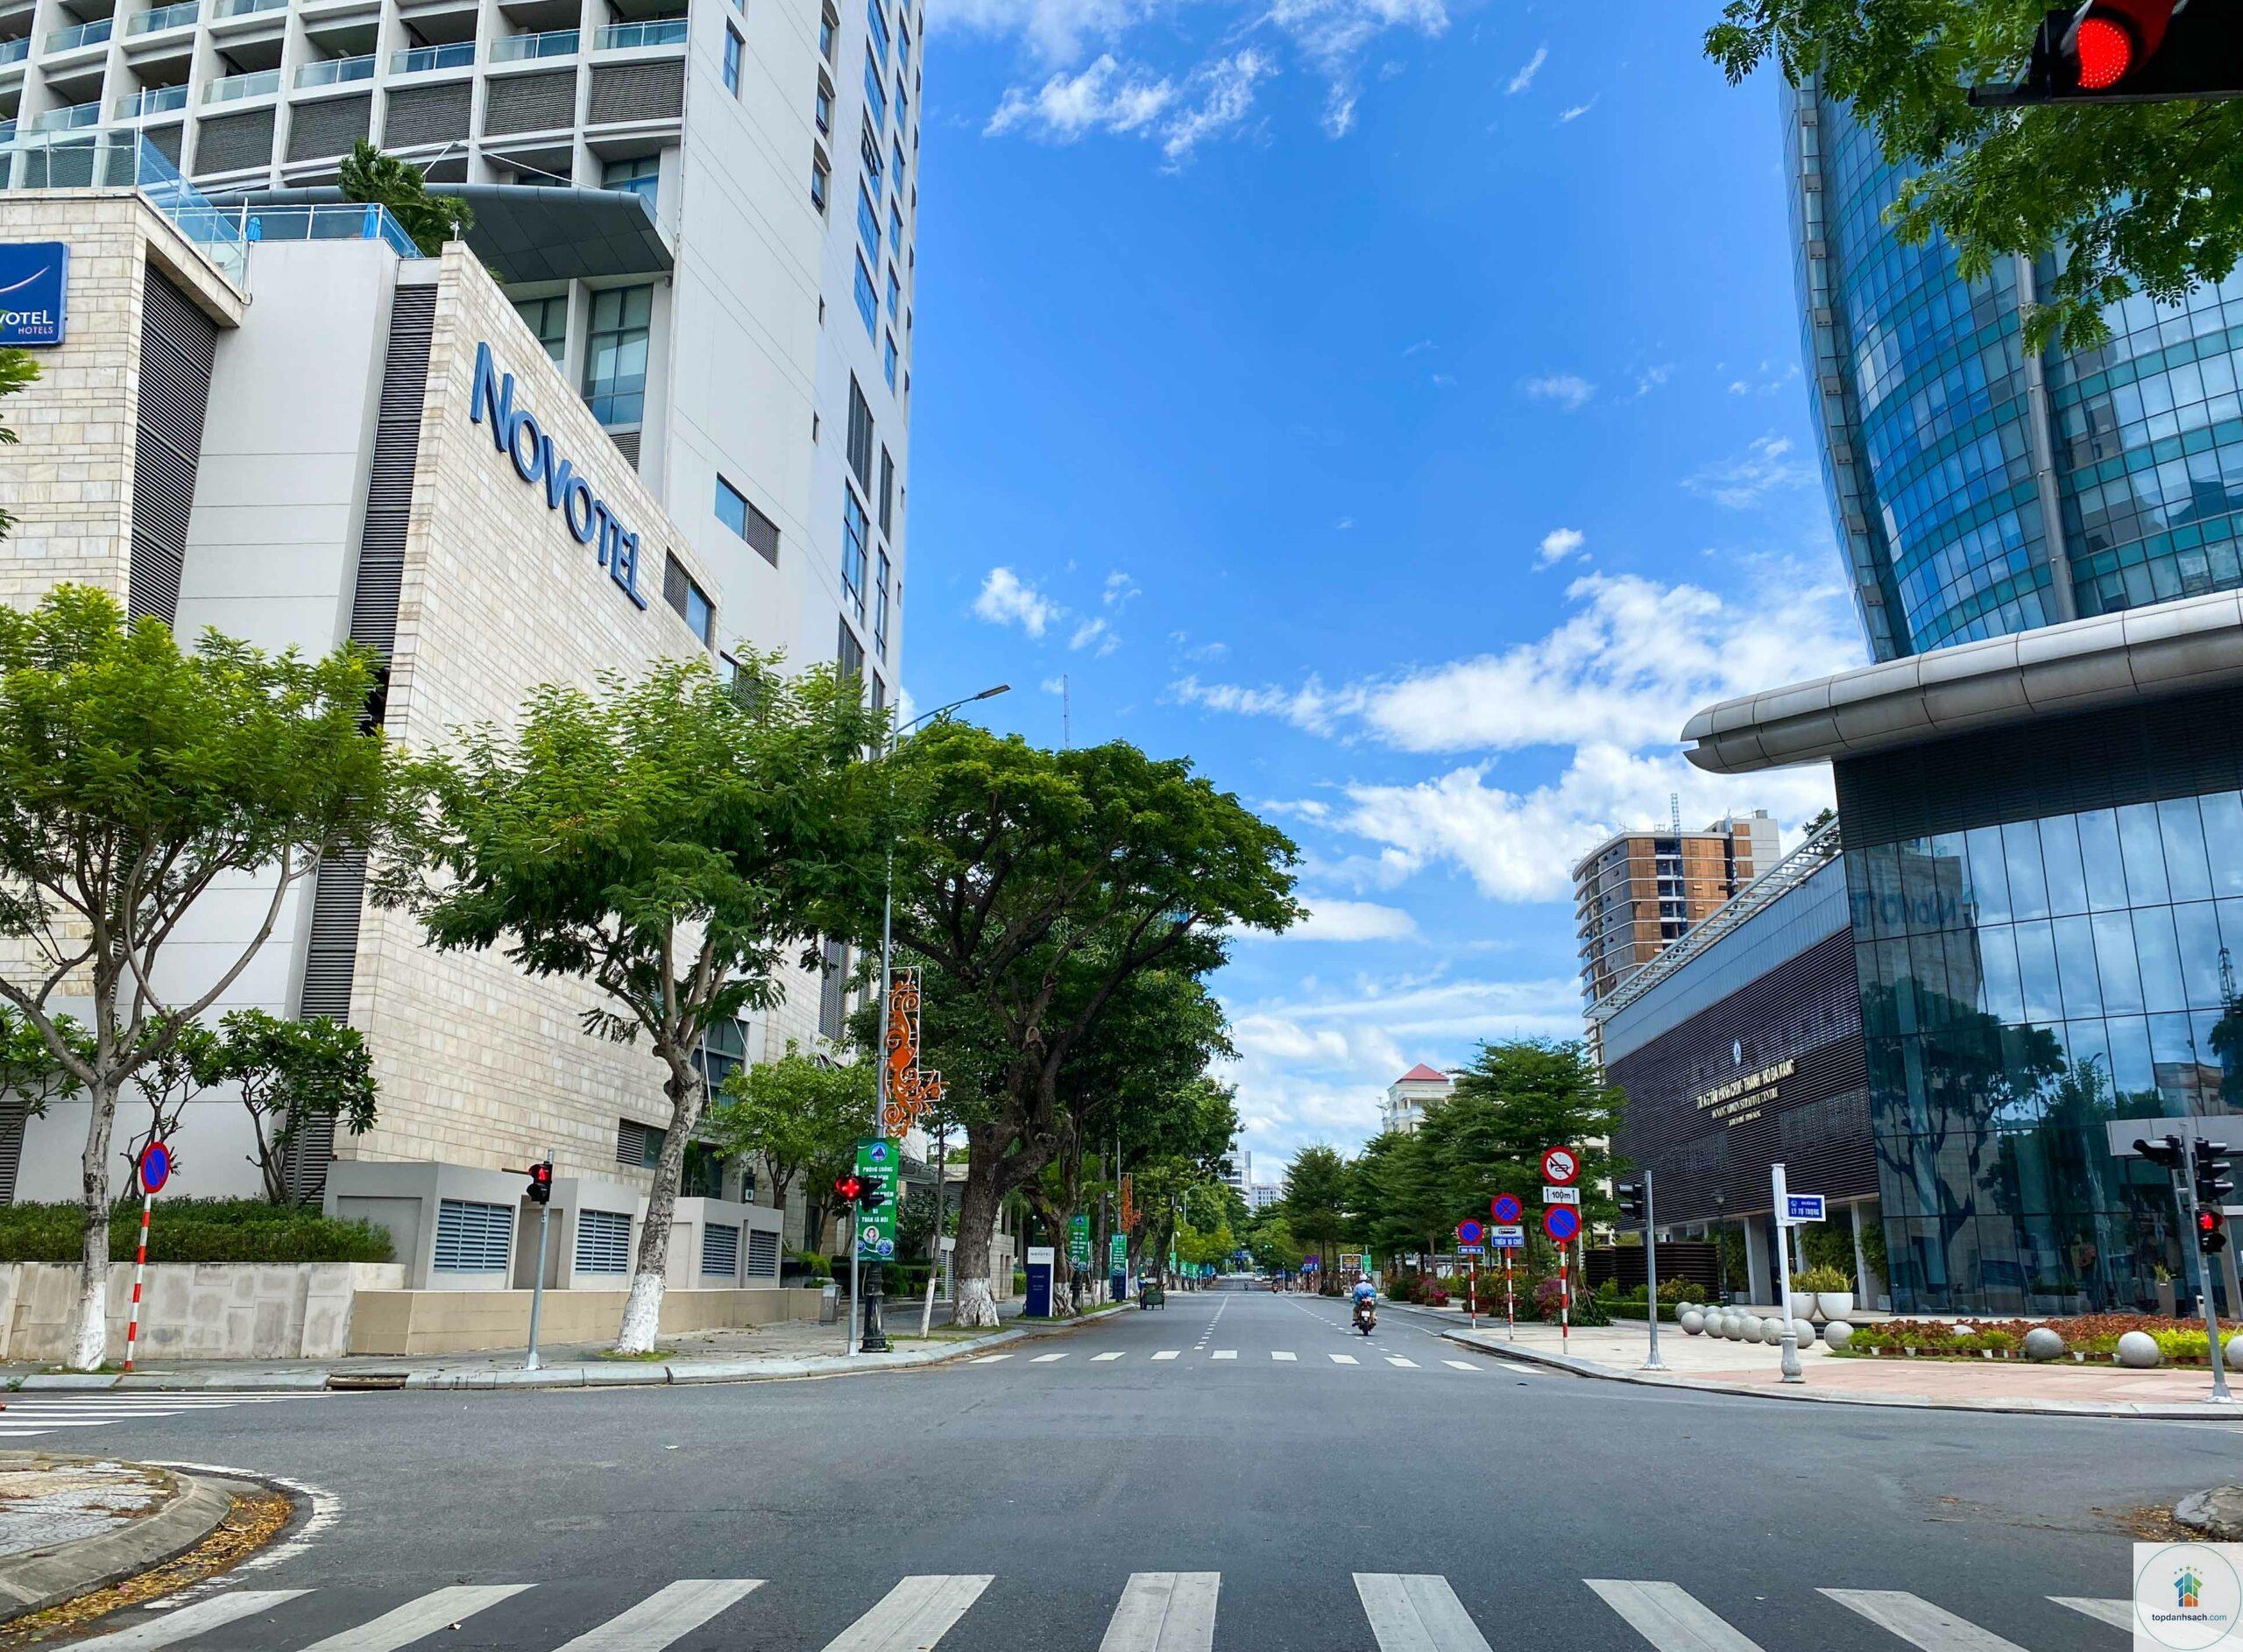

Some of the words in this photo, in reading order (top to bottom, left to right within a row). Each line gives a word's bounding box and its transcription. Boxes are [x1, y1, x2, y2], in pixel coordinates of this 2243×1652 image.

[18, 326, 53, 335] HOTELS
[470, 341, 647, 611] NOVOTEL
[1552, 1190, 1571, 1199] 100m
